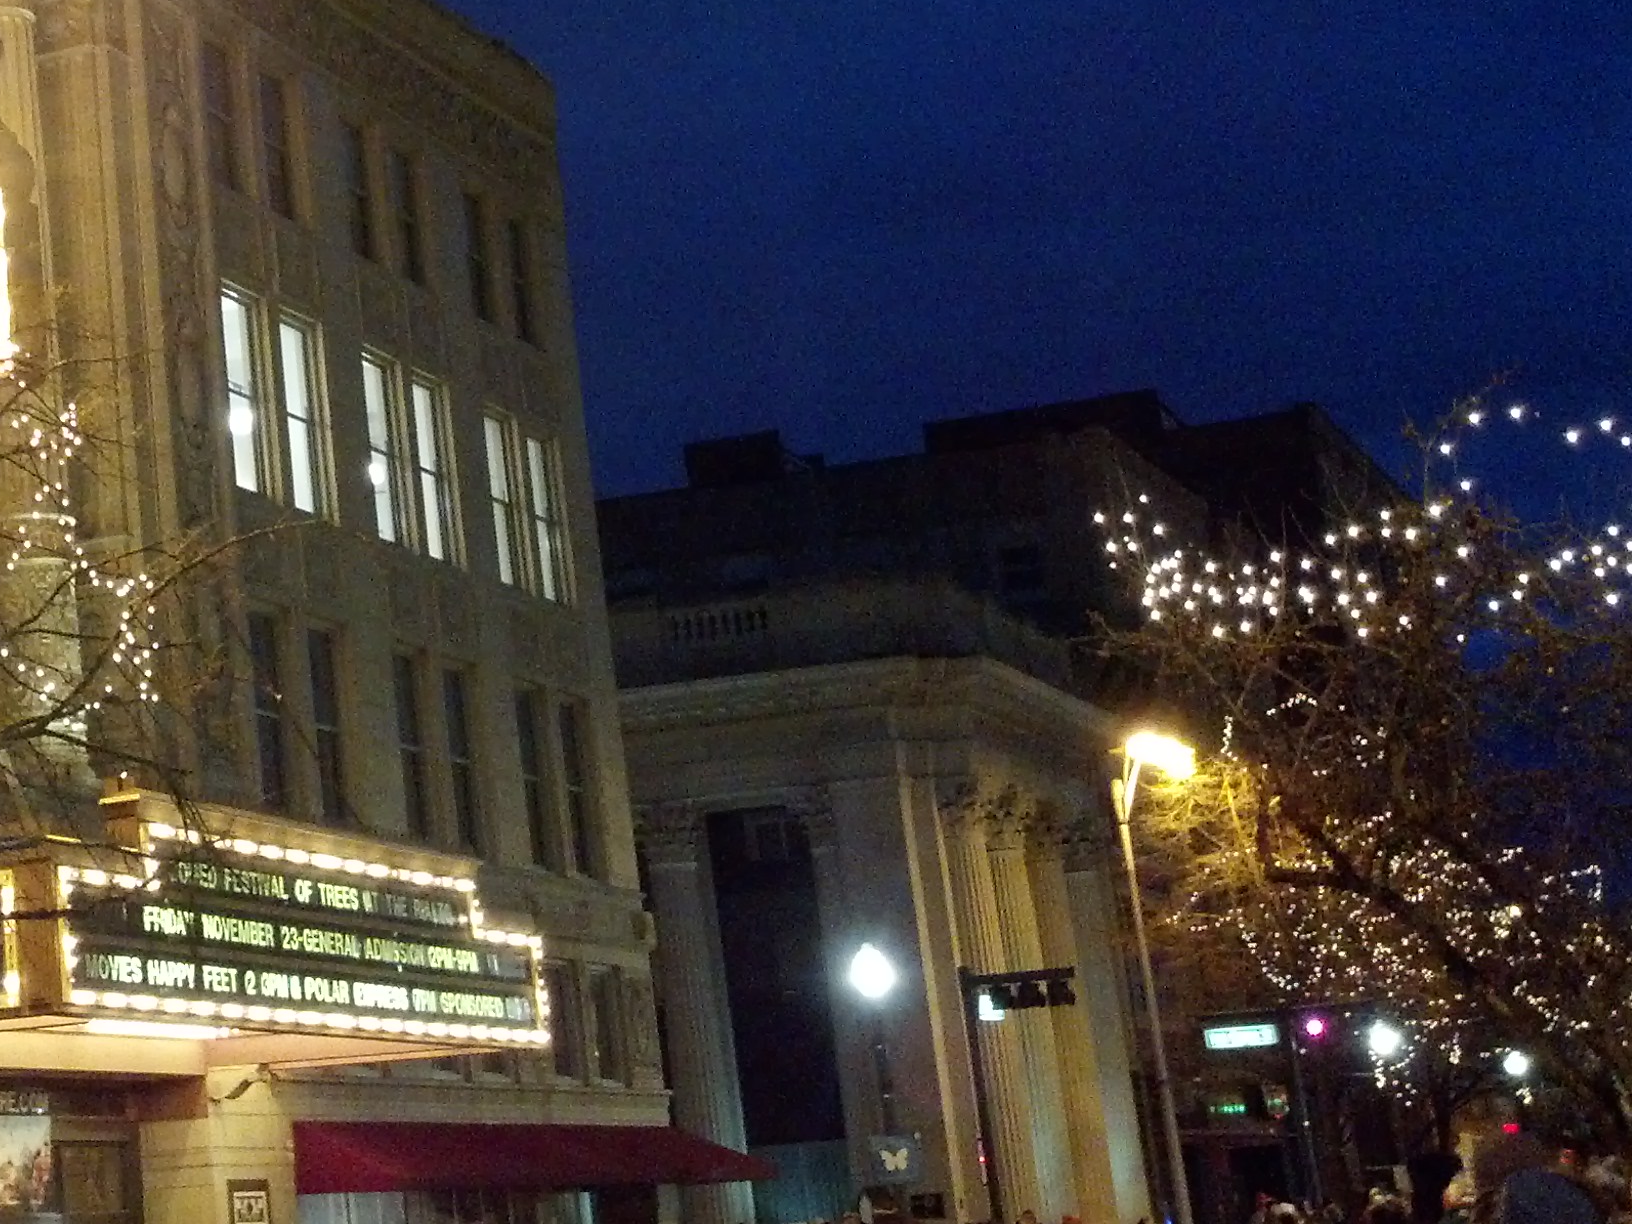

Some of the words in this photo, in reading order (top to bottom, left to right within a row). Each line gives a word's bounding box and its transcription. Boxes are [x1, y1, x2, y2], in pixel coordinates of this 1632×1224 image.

[224, 868, 289, 900] FESTIVAL
[294, 878, 313, 903] OF
[317, 883, 359, 910] TREES
[201, 913, 275, 948] NOVEMBER
[85, 953, 143, 984] MOVIES
[147, 959, 195, 989] HAPPY
[202, 964, 238, 993] FEET
[304, 976, 350, 1004] POLAR
[440, 991, 505, 1018] SPONSORED
